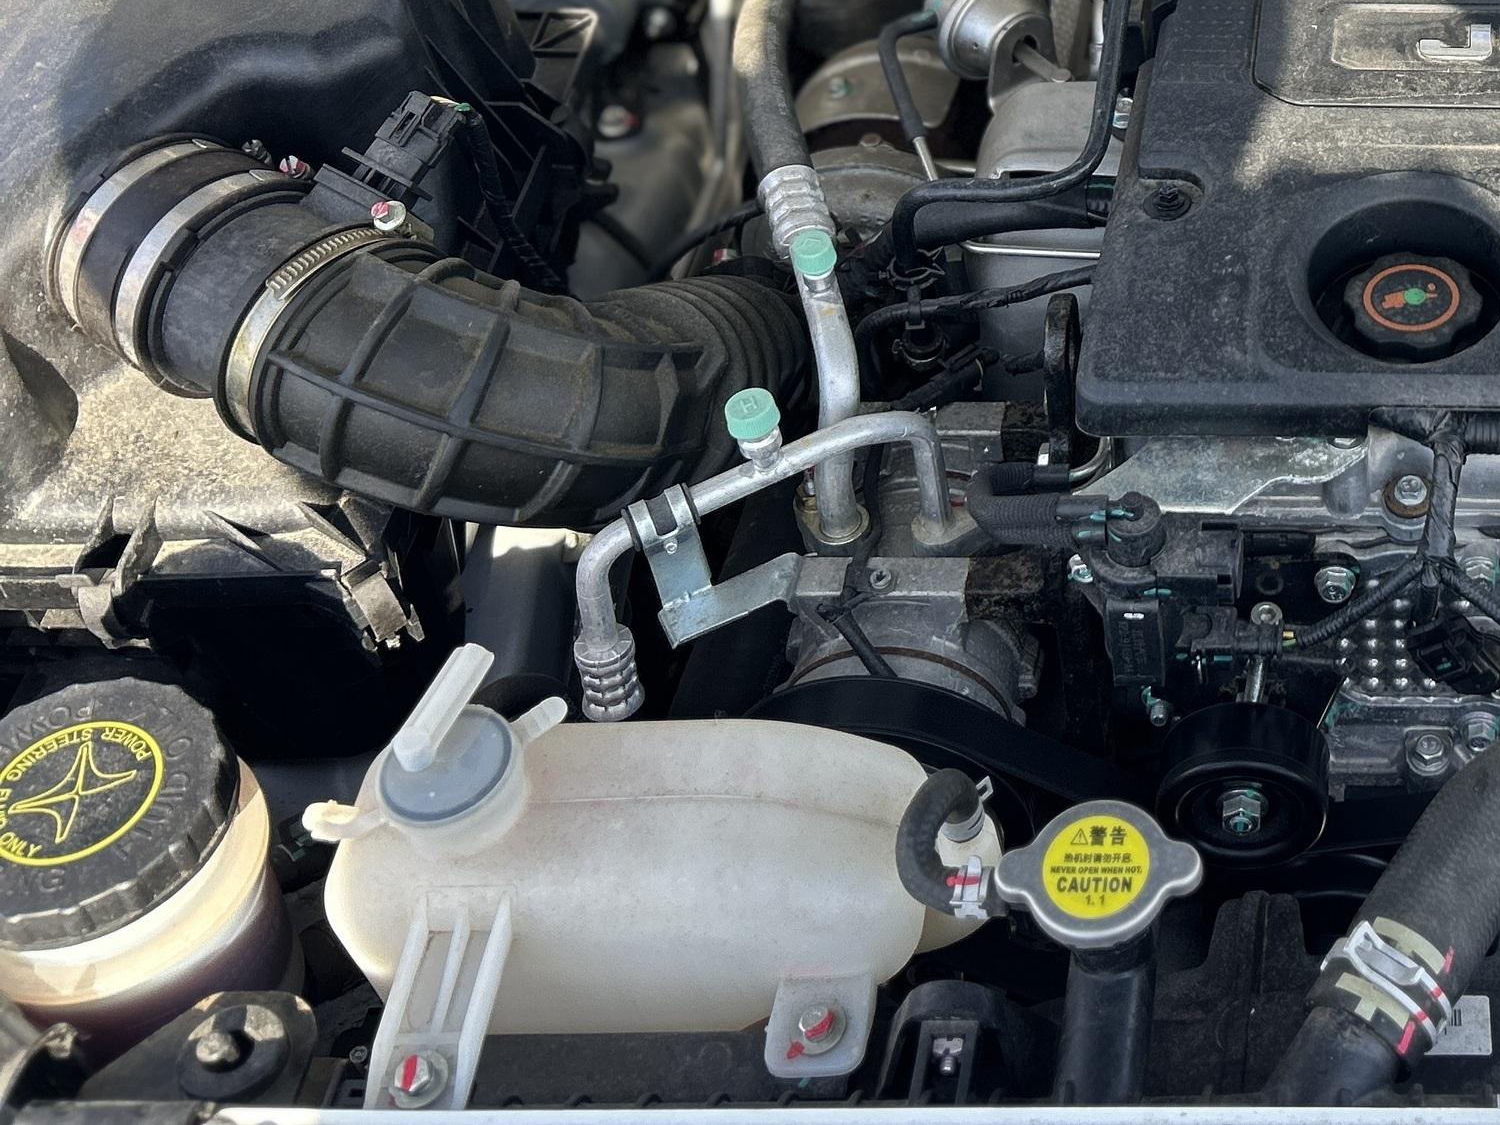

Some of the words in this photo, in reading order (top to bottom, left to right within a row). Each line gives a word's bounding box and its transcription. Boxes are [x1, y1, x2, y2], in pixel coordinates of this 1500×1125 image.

[6, 728, 93, 782] STEERING
[100, 727, 152, 762] POWER
[0, 832, 42, 858] ONLY
[1090, 826, 1126, 846] 警告
[1057, 876, 1133, 893] CAUTION
